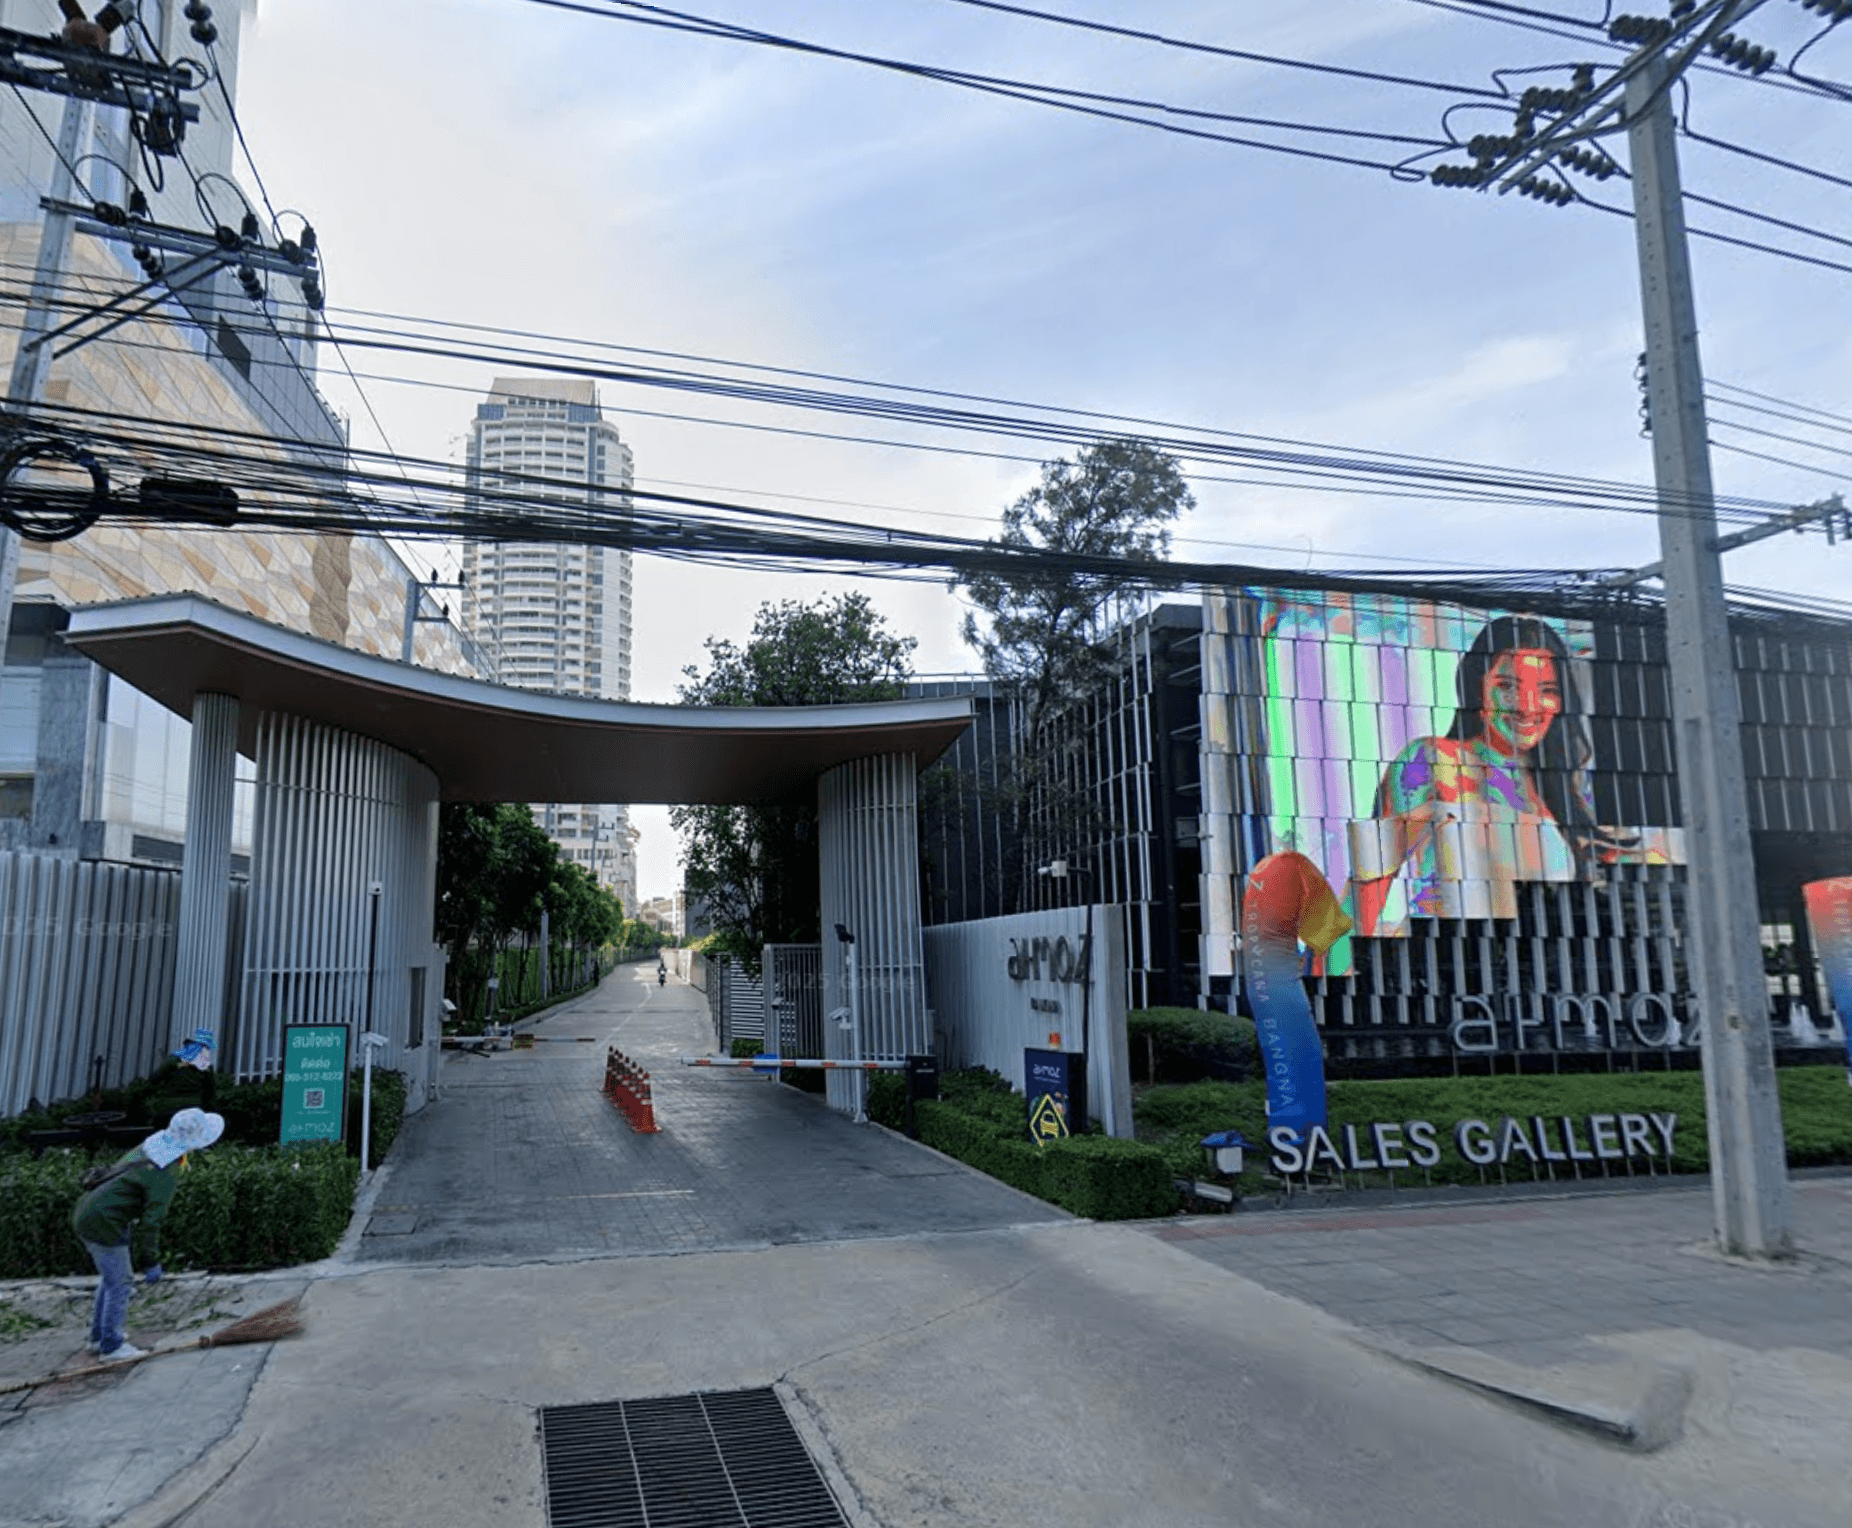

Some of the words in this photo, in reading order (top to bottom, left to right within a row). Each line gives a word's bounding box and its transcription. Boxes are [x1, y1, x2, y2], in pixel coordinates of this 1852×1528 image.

[1263, 1018, 1295, 1106] BANGNA
[1268, 1119, 1441, 1173] SALES
[1456, 1111, 1677, 1165] GALLERY
